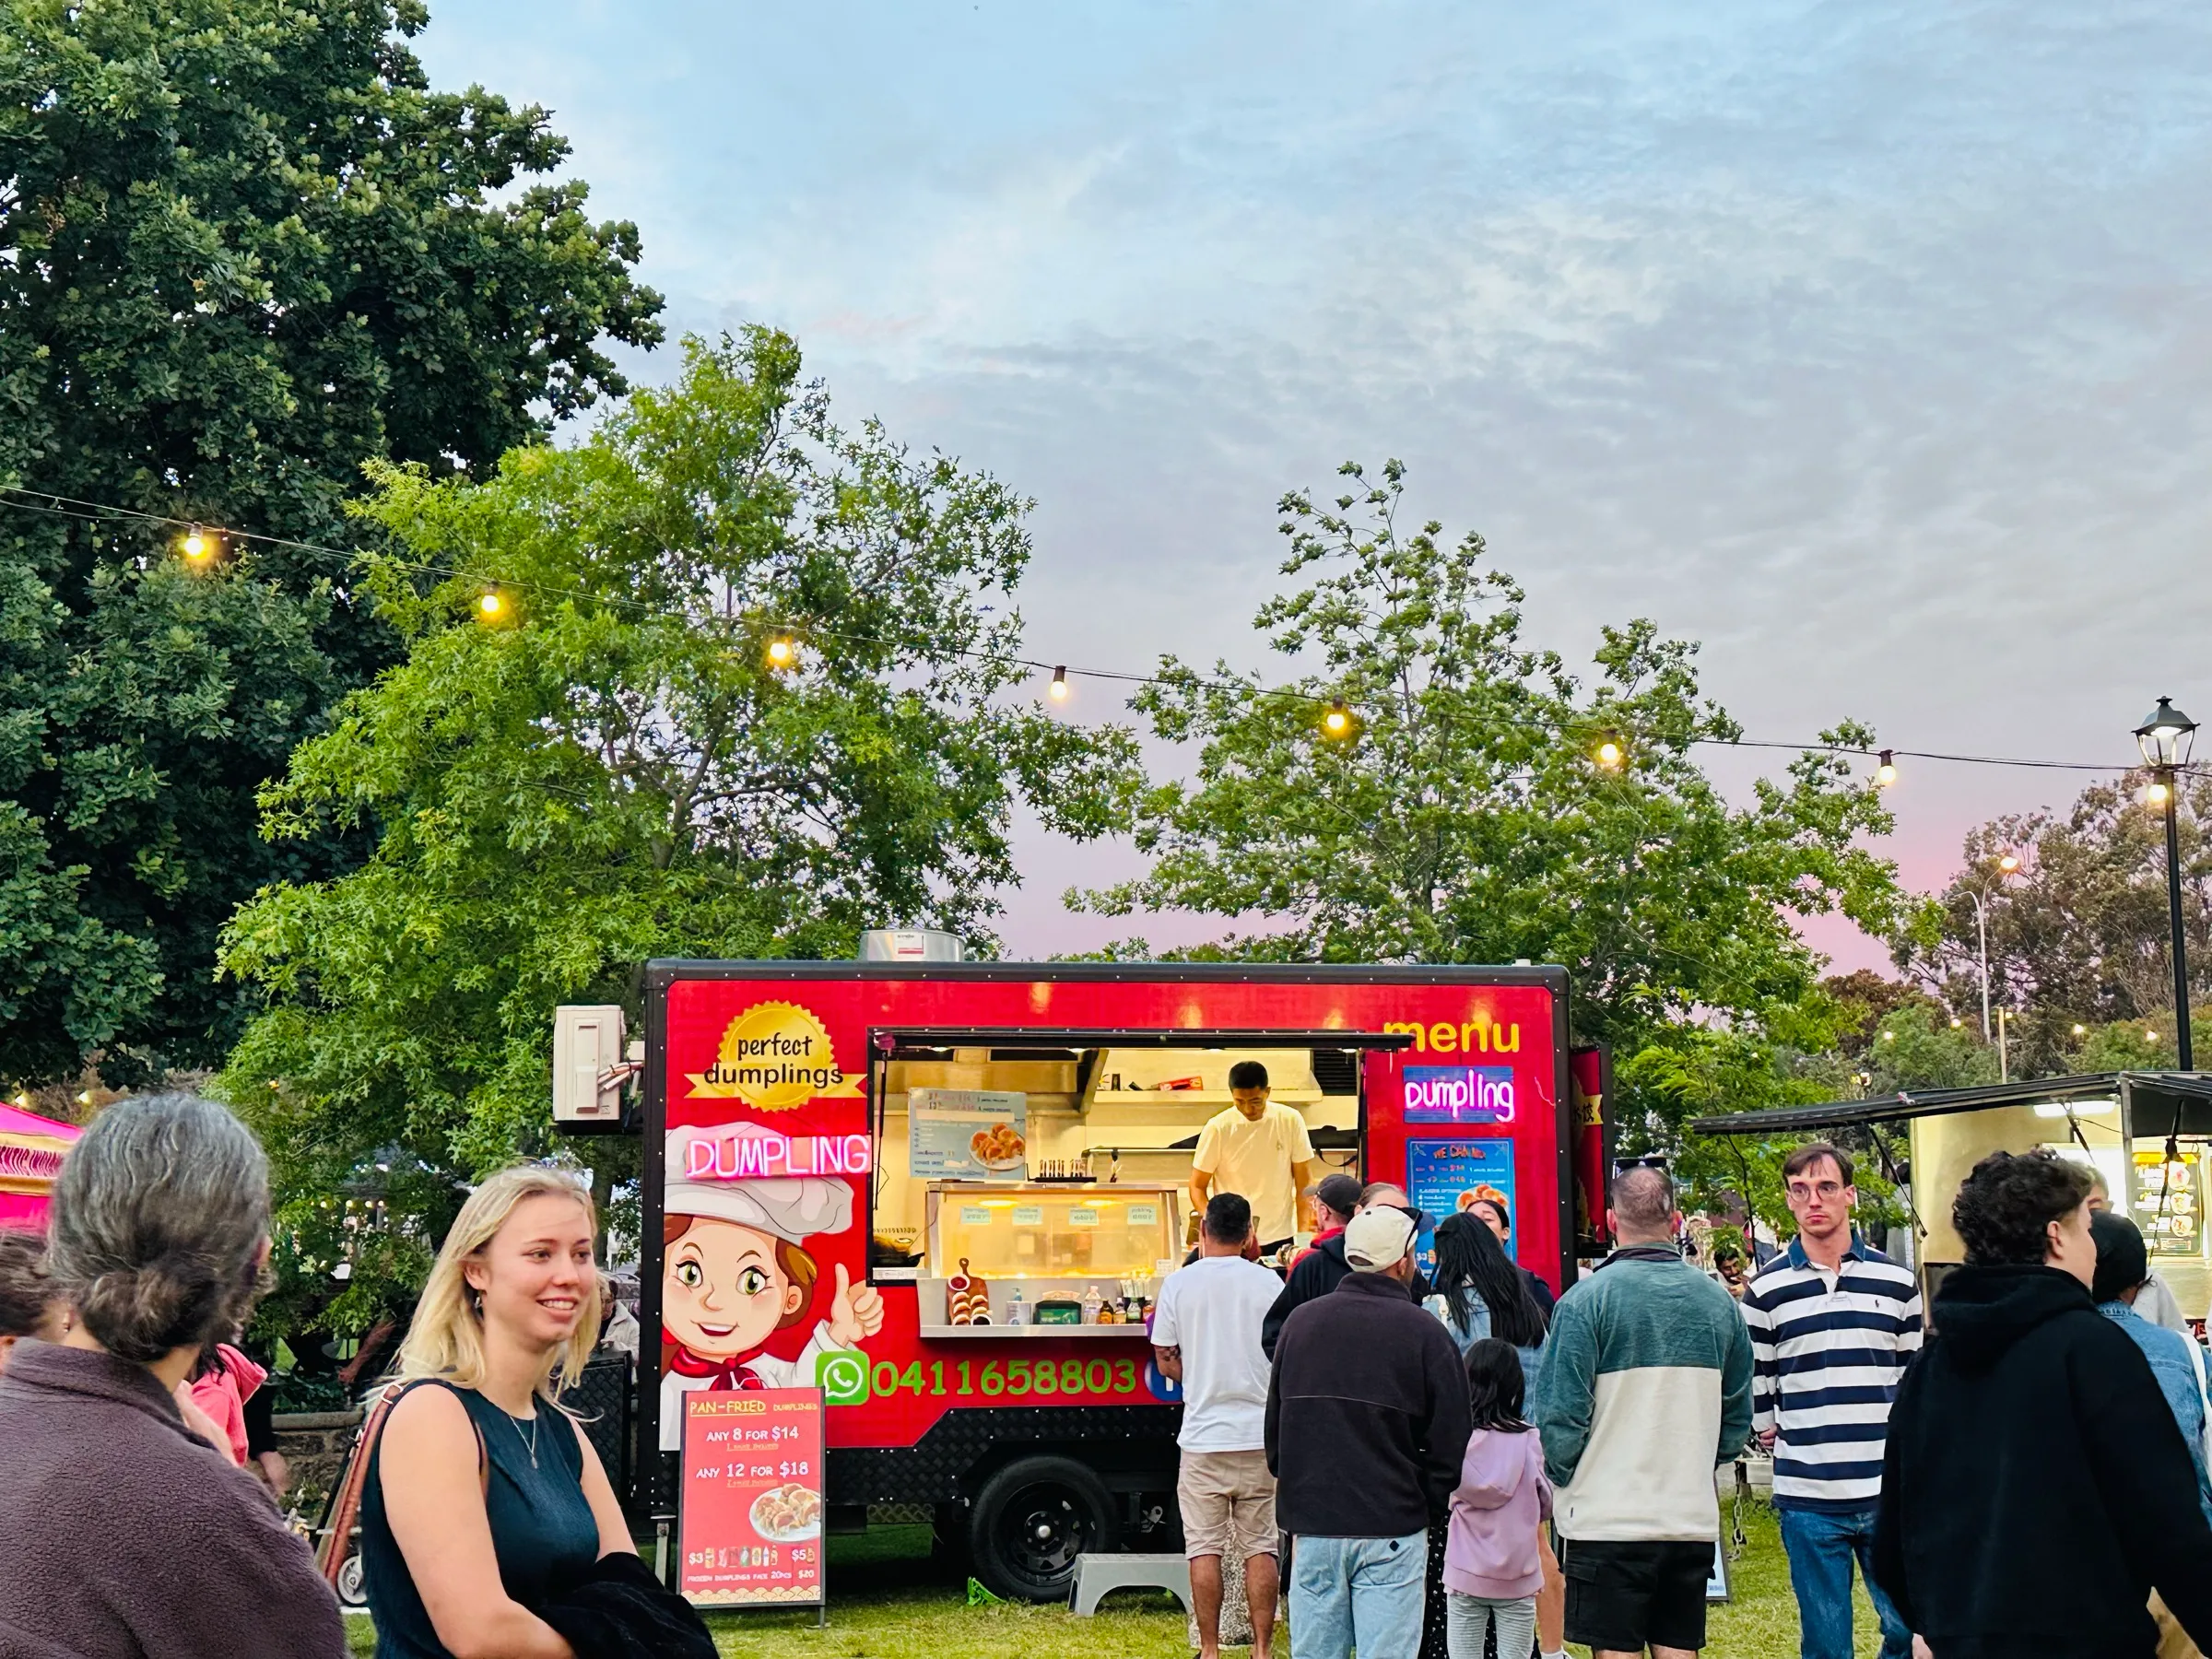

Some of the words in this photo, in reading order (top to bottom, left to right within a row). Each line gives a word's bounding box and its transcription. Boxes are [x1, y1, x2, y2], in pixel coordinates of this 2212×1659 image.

[737, 1032, 813, 1061] perfect
[1383, 1022, 1520, 1053] menu
[703, 1064, 844, 1088] dumplings
[686, 1135, 869, 1178] DUMPLING
[871, 1359, 1137, 1398] 0411658803
[689, 1400, 766, 1414] PAN-FRIED
[706, 1430, 730, 1441] ANY
[733, 1428, 742, 1441] 8
[746, 1430, 769, 1441] FOR
[771, 1426, 799, 1441] $14
[696, 1467, 720, 1478] ANY
[726, 1463, 745, 1477] 12
[750, 1466, 774, 1477] FOR
[779, 1461, 809, 1478] $18
[688, 1552, 703, 1566] $3
[792, 1548, 806, 1562] $5
[798, 1570, 815, 1580] $20
